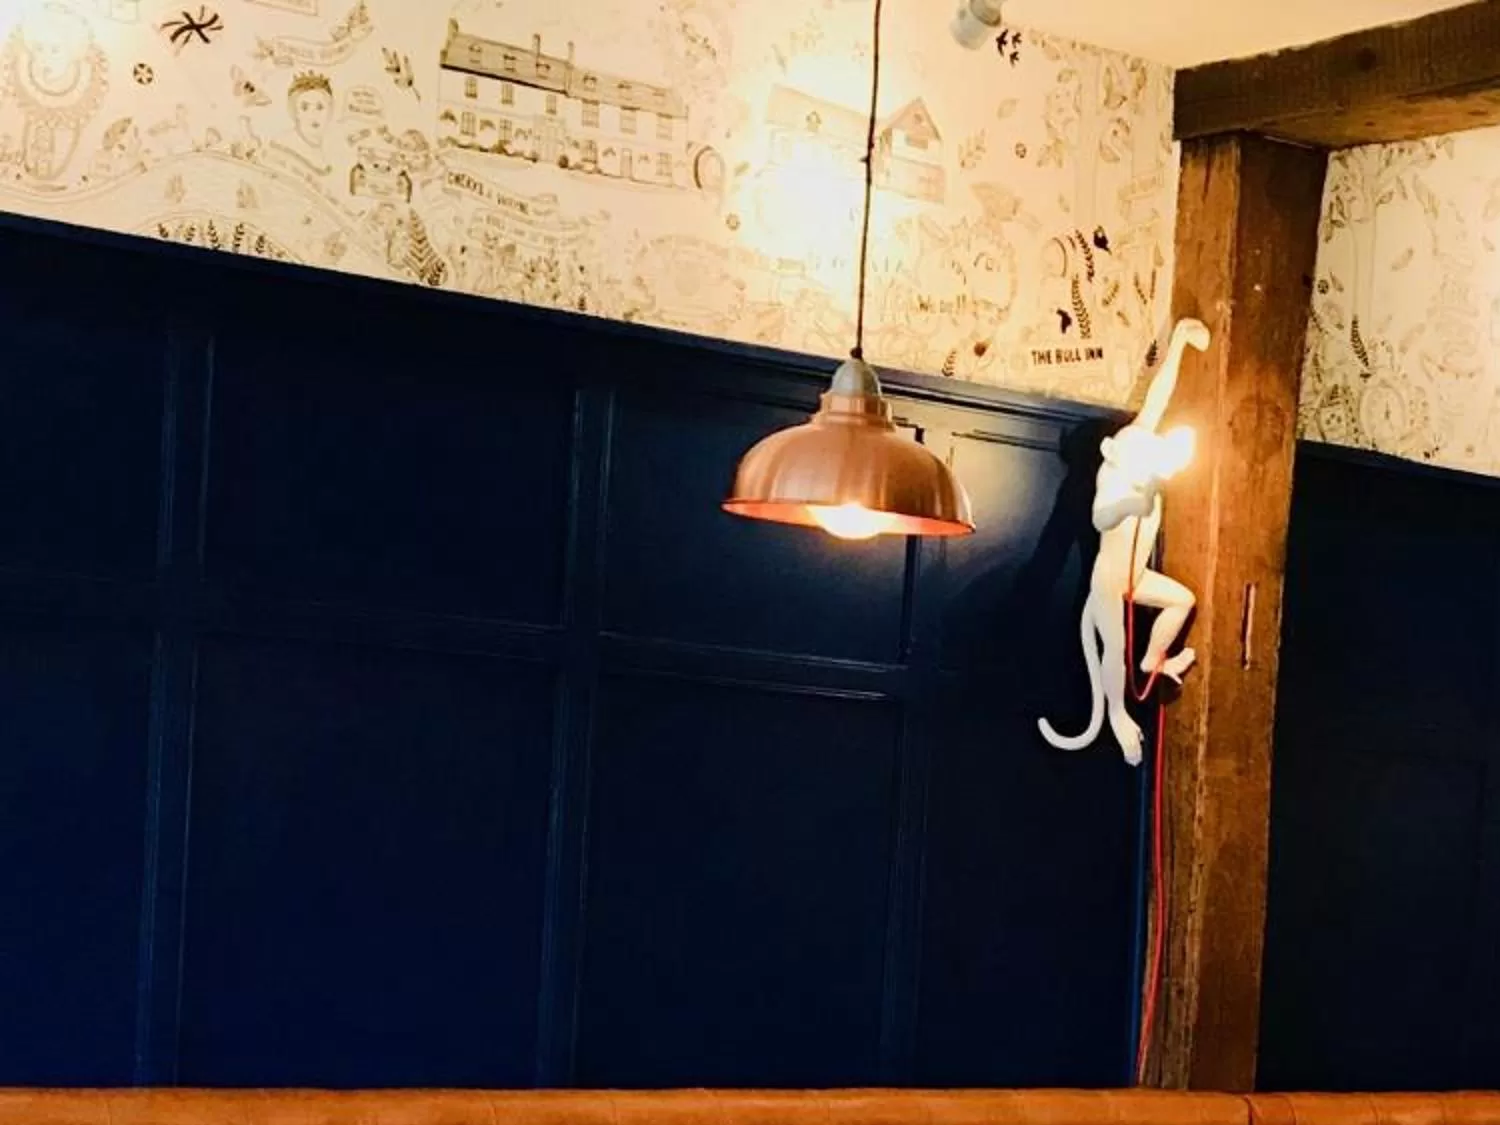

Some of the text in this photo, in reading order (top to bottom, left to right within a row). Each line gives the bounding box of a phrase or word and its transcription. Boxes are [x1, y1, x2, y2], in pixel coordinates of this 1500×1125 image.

[1031, 346, 1104, 366] THE BULL INN
